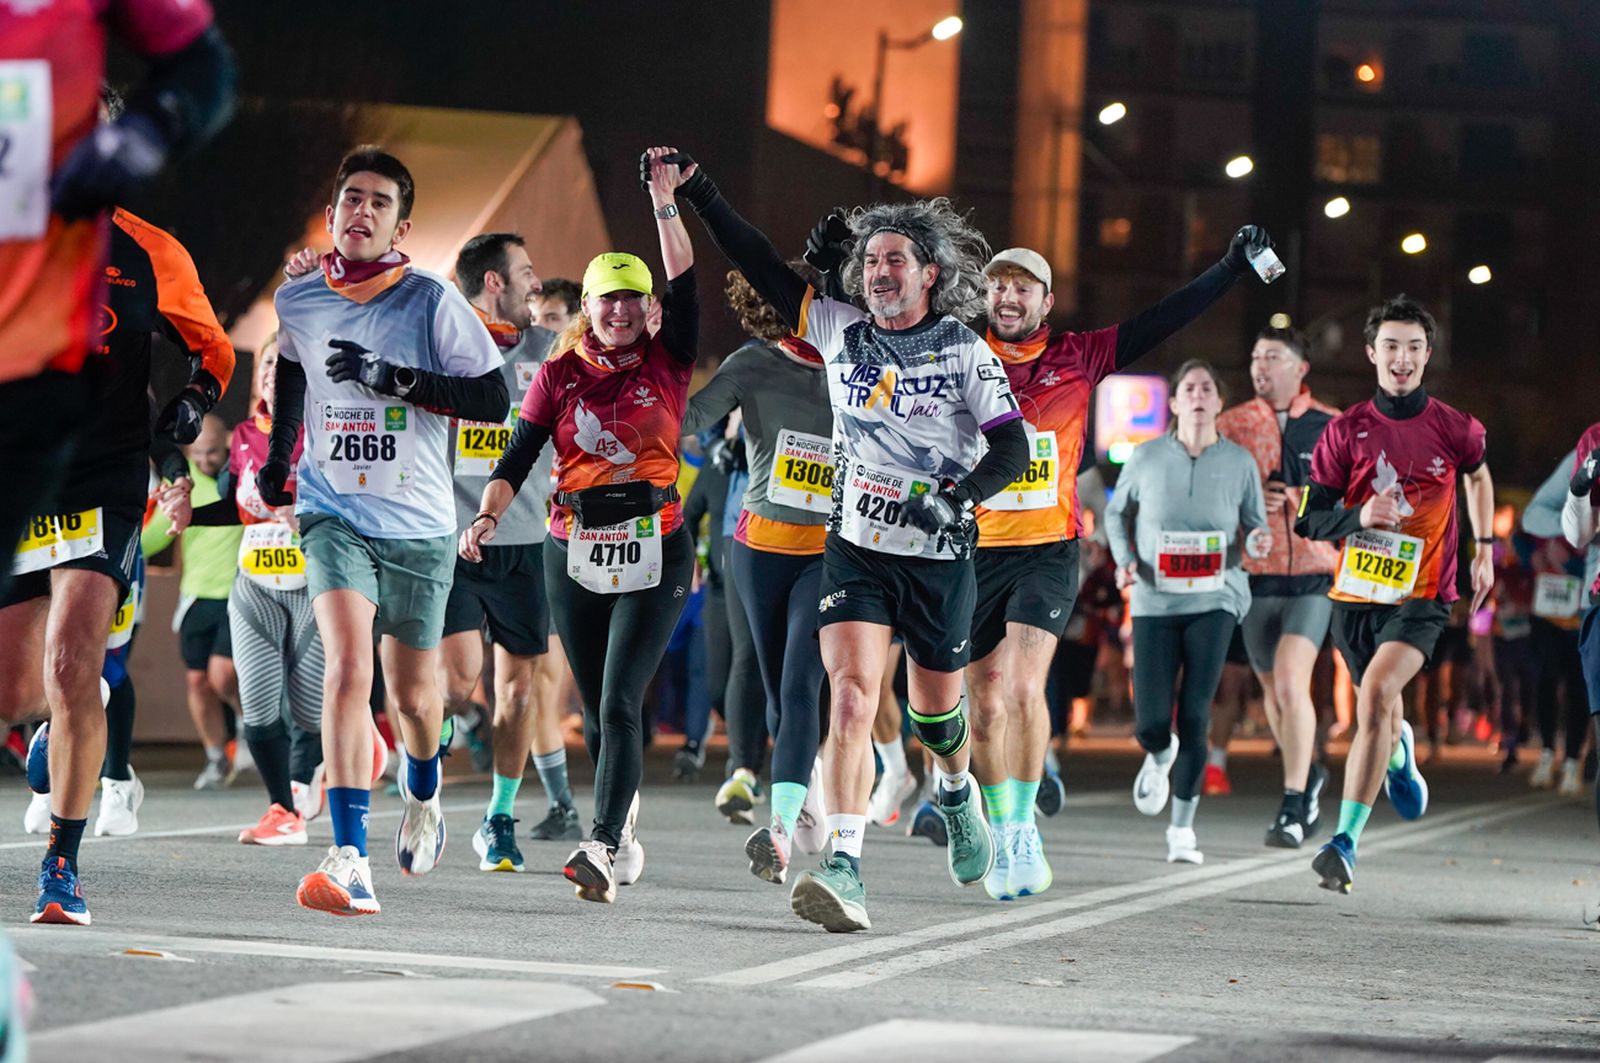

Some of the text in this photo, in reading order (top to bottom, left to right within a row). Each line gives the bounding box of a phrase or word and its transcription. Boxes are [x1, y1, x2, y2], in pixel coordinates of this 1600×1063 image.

[334, 411, 376, 420] NOCHE DE
[342, 419, 376, 432] ANTÓN
[330, 434, 396, 462] 2668
[595, 437, 619, 457] 43
[785, 447, 802, 459] SAN
[796, 441, 820, 451] NOCHE
[822, 446, 831, 454] DE
[785, 458, 834, 488] 1308
[865, 472, 891, 487] NOCHE
[892, 479, 904, 490] DE
[853, 478, 902, 499] SAN ANTÓN
[579, 531, 598, 541] SAN
[253, 548, 297, 568] 7505
[589, 541, 641, 567] 4710
[1356, 551, 1407, 581] 12782
